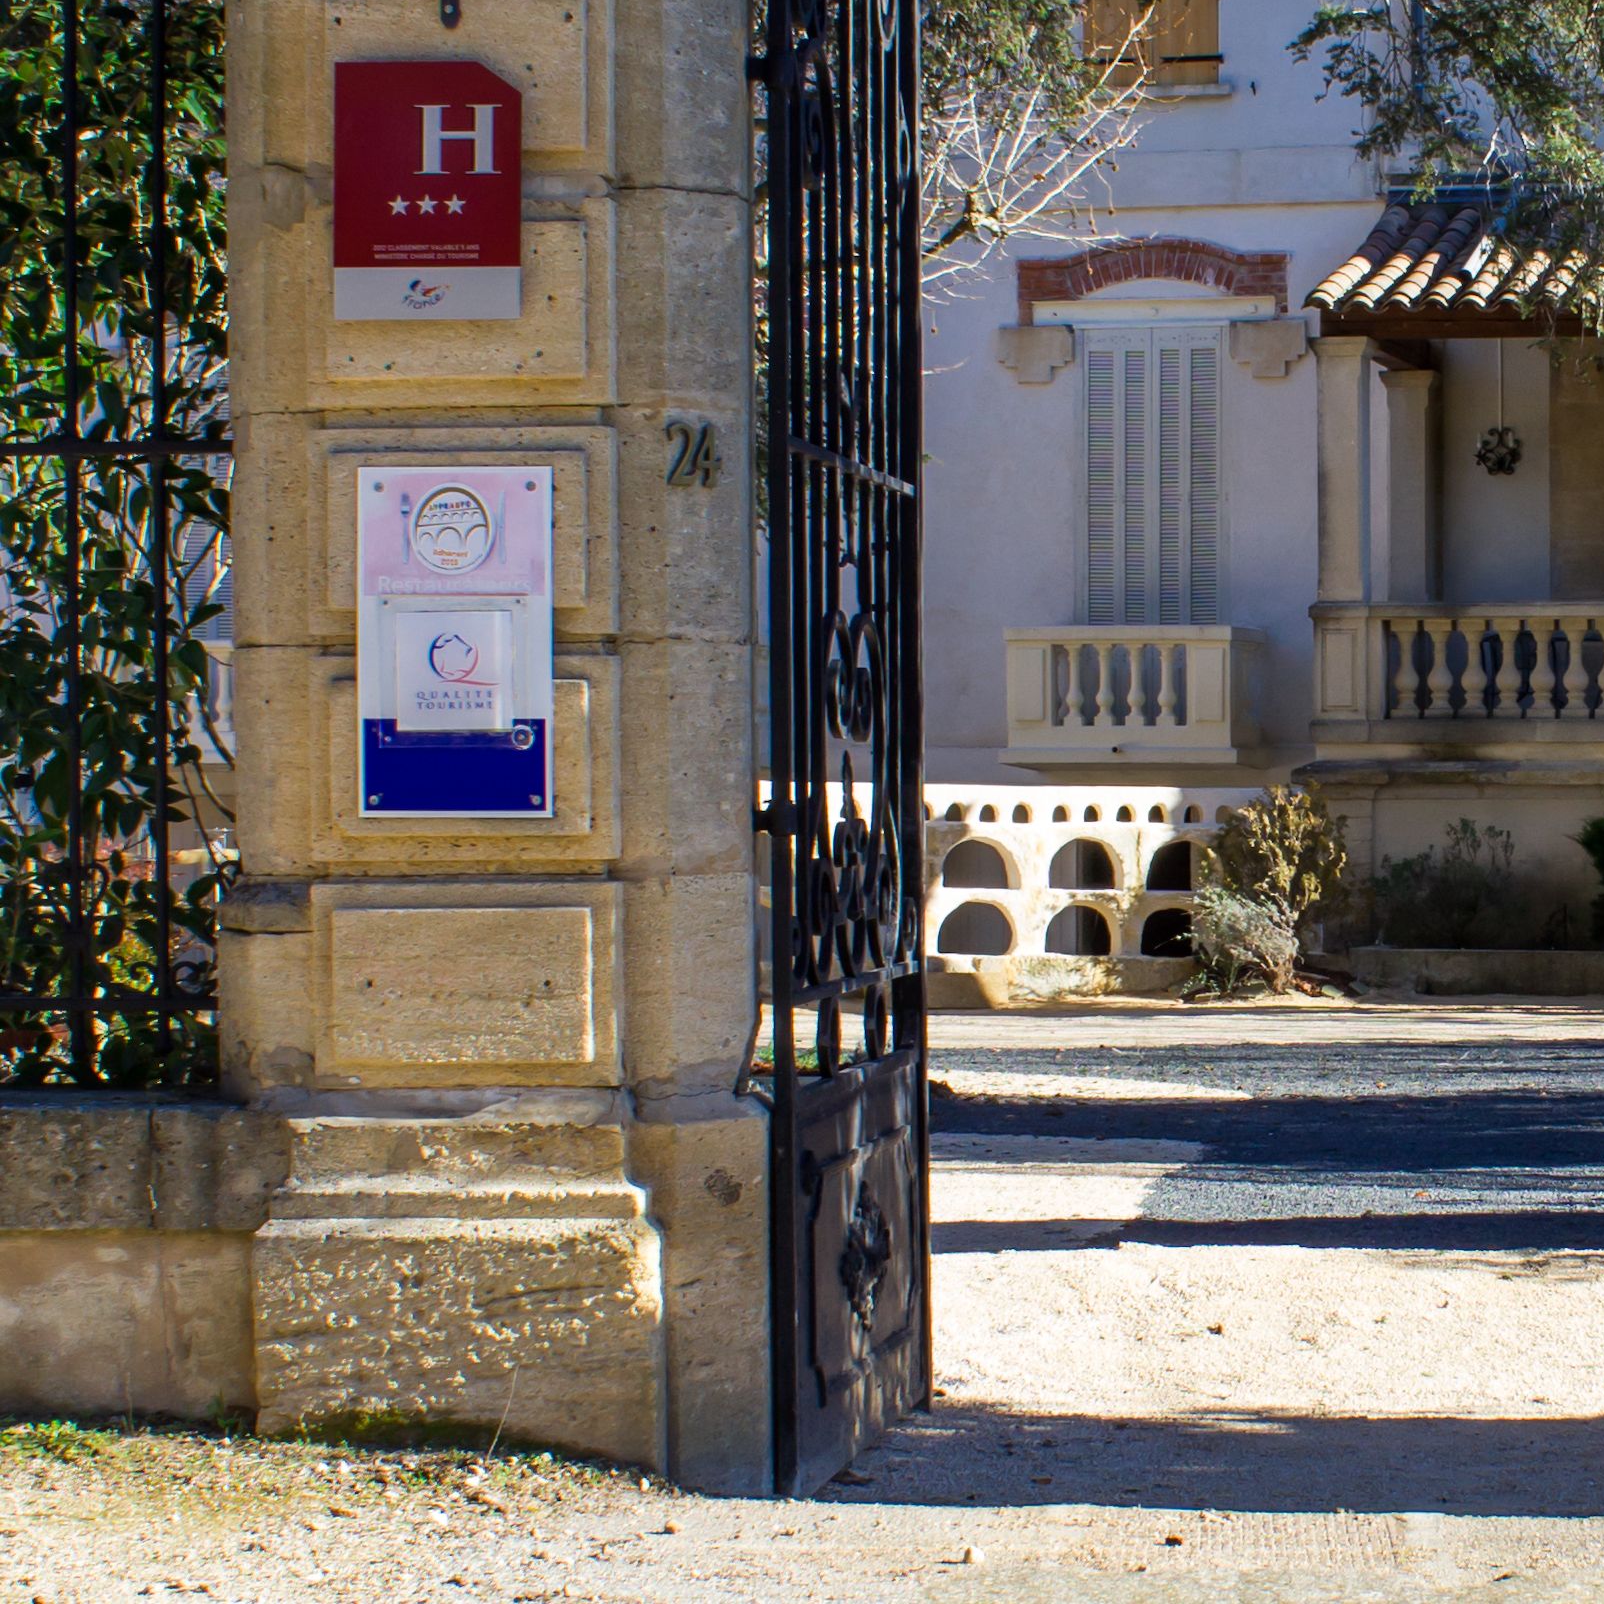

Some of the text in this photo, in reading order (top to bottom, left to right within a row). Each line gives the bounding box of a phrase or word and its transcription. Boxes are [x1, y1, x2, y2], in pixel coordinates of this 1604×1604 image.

[413, 103, 502, 174] H
[664, 420, 722, 488] 24
[417, 701, 492, 709] TOURISME
